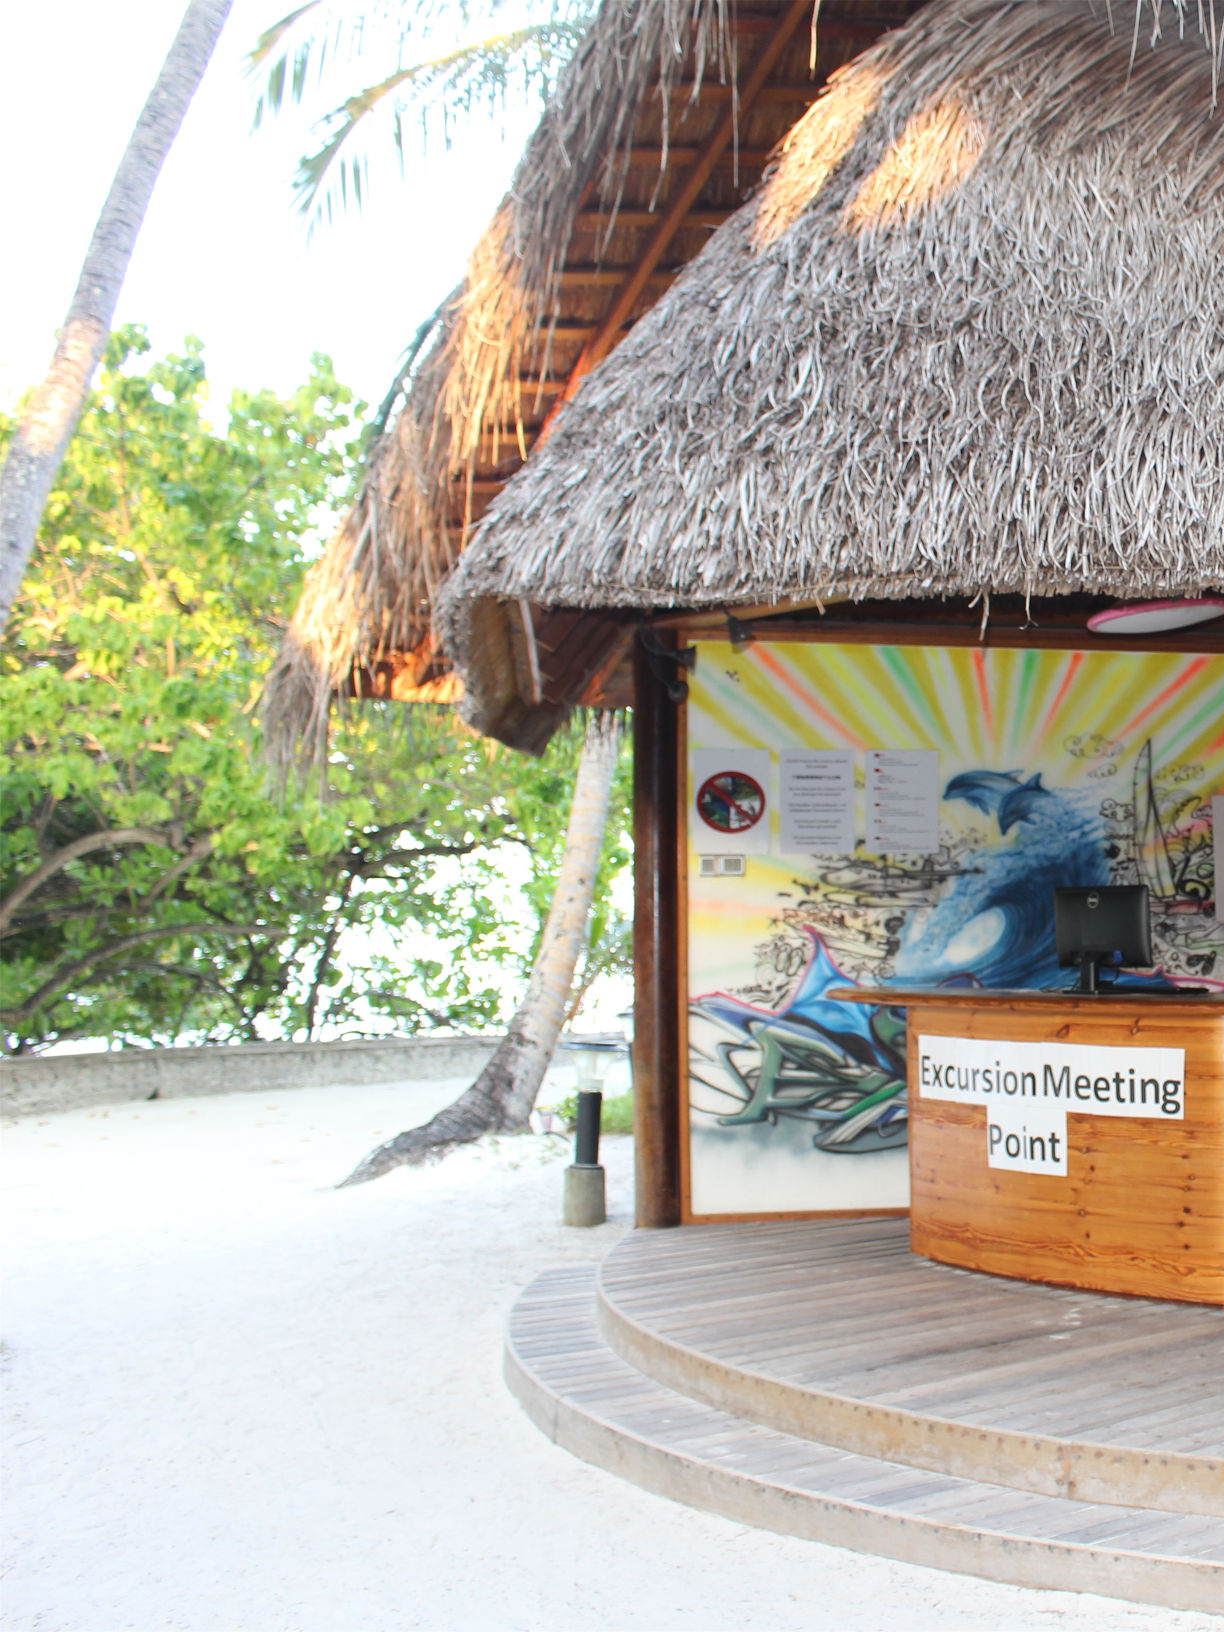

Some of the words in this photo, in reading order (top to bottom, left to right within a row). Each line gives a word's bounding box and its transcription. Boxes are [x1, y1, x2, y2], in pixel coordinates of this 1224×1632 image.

[920, 1055, 1037, 1097] Excursion
[1043, 1063, 1182, 1115] Meeting
[988, 1123, 1061, 1163] Point
